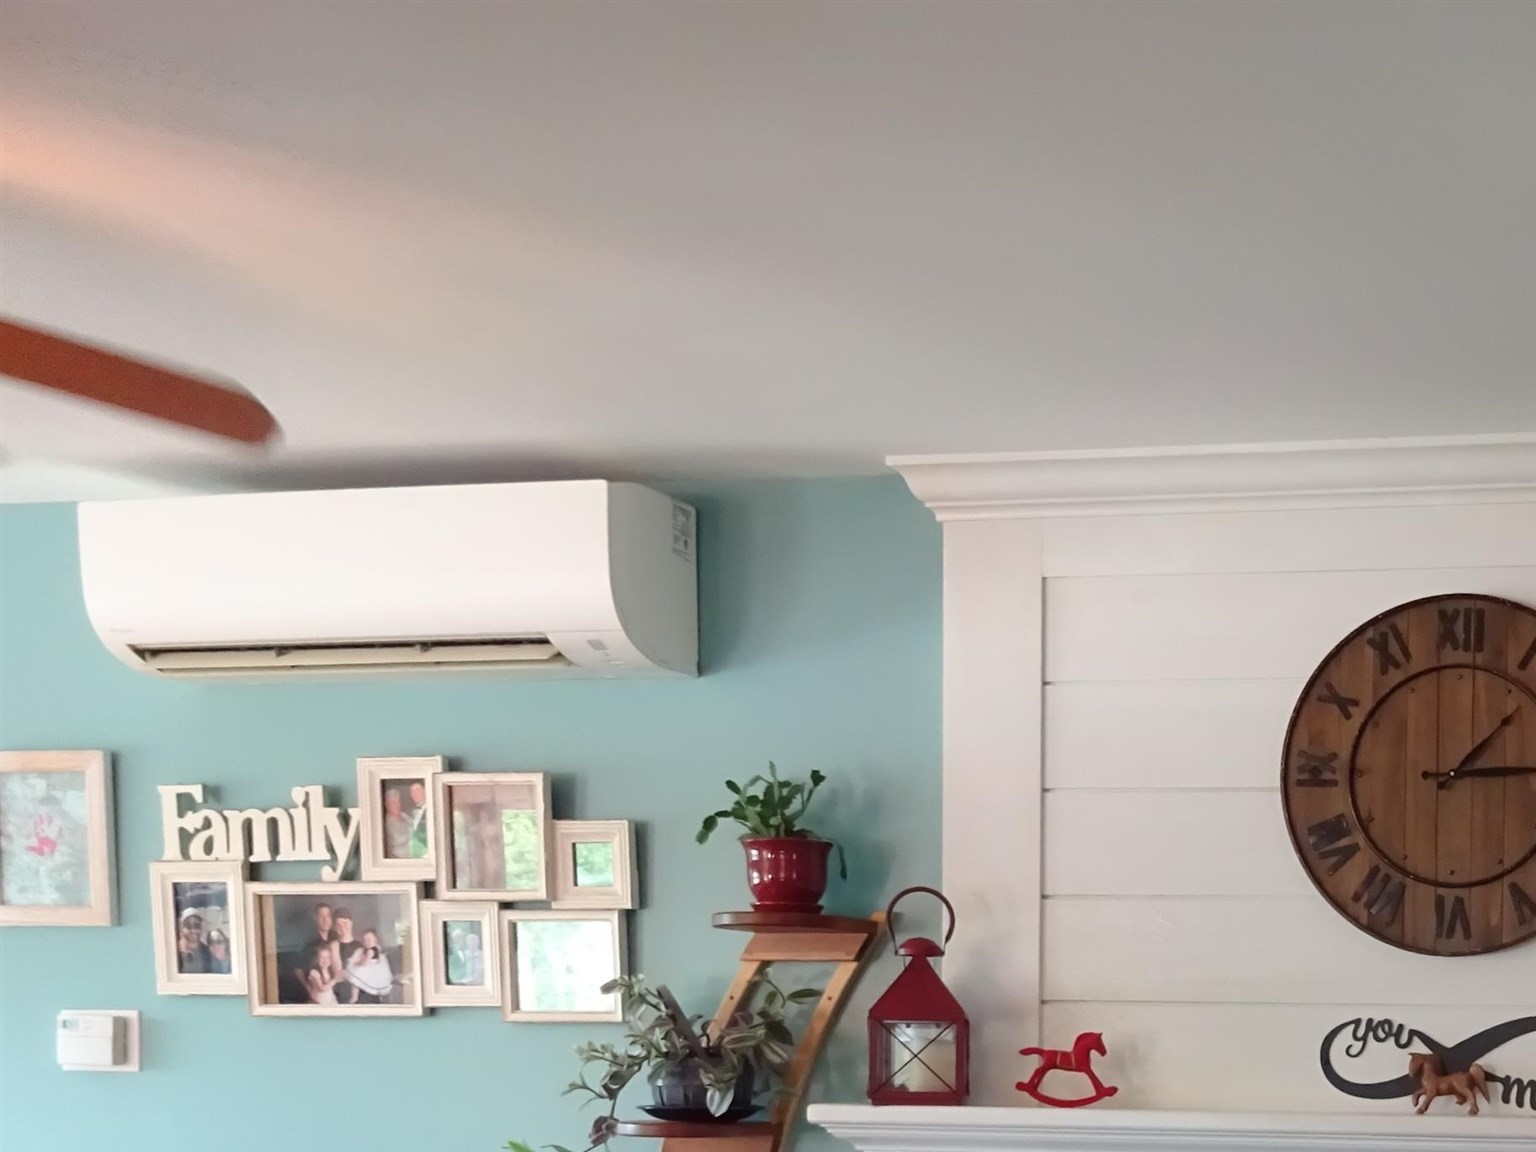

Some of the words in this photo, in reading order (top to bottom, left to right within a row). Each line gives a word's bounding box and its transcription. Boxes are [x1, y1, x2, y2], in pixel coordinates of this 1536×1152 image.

[1367, 622, 1412, 675] XI
[1437, 607, 1485, 653] XII
[1316, 681, 1360, 721] X
[156, 783, 361, 882] Family
[1435, 894, 1471, 940] VI
[1345, 1016, 1415, 1058] you
